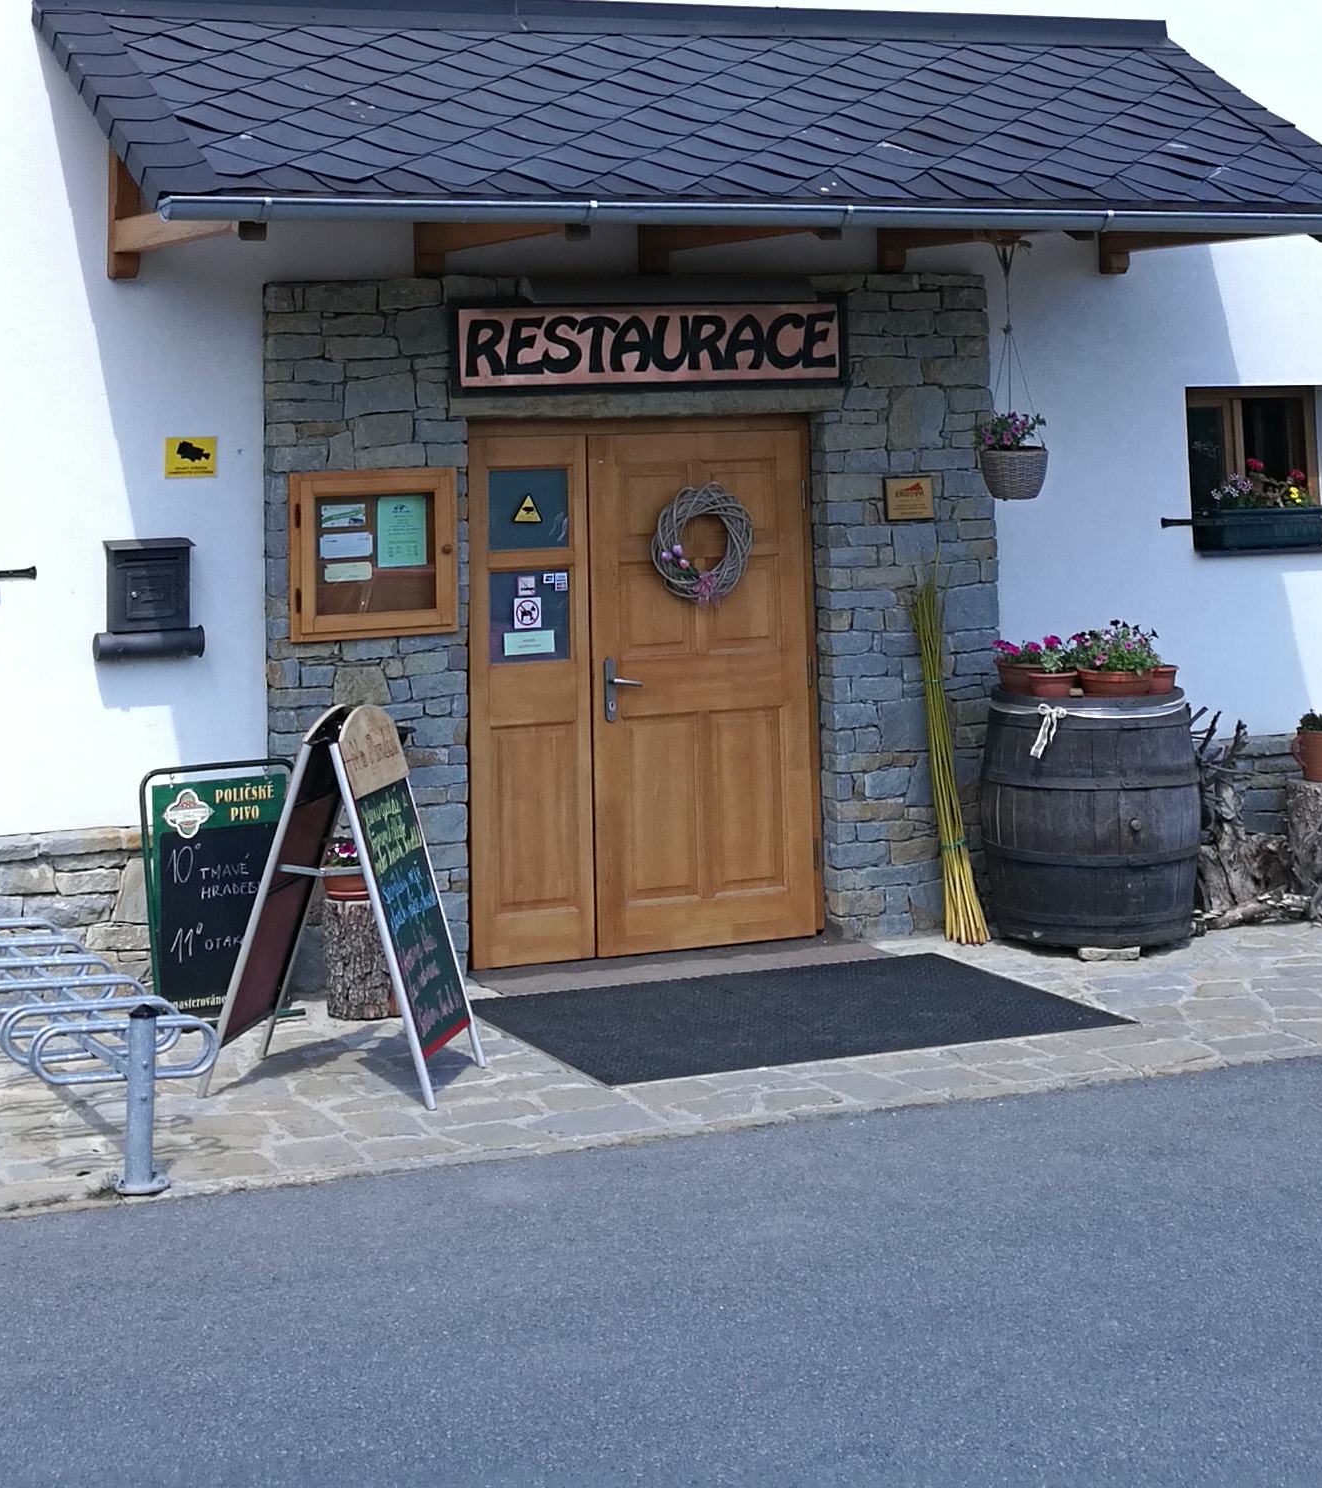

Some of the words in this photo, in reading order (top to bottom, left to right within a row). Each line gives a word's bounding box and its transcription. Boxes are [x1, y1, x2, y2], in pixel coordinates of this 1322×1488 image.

[465, 311, 837, 378] RESTAURACE
[215, 781, 275, 804] POLIČSKÉ
[230, 805, 260, 822] PIVO
[199, 852, 251, 880] TMAVÉ
[201, 881, 261, 900] HRADEB
